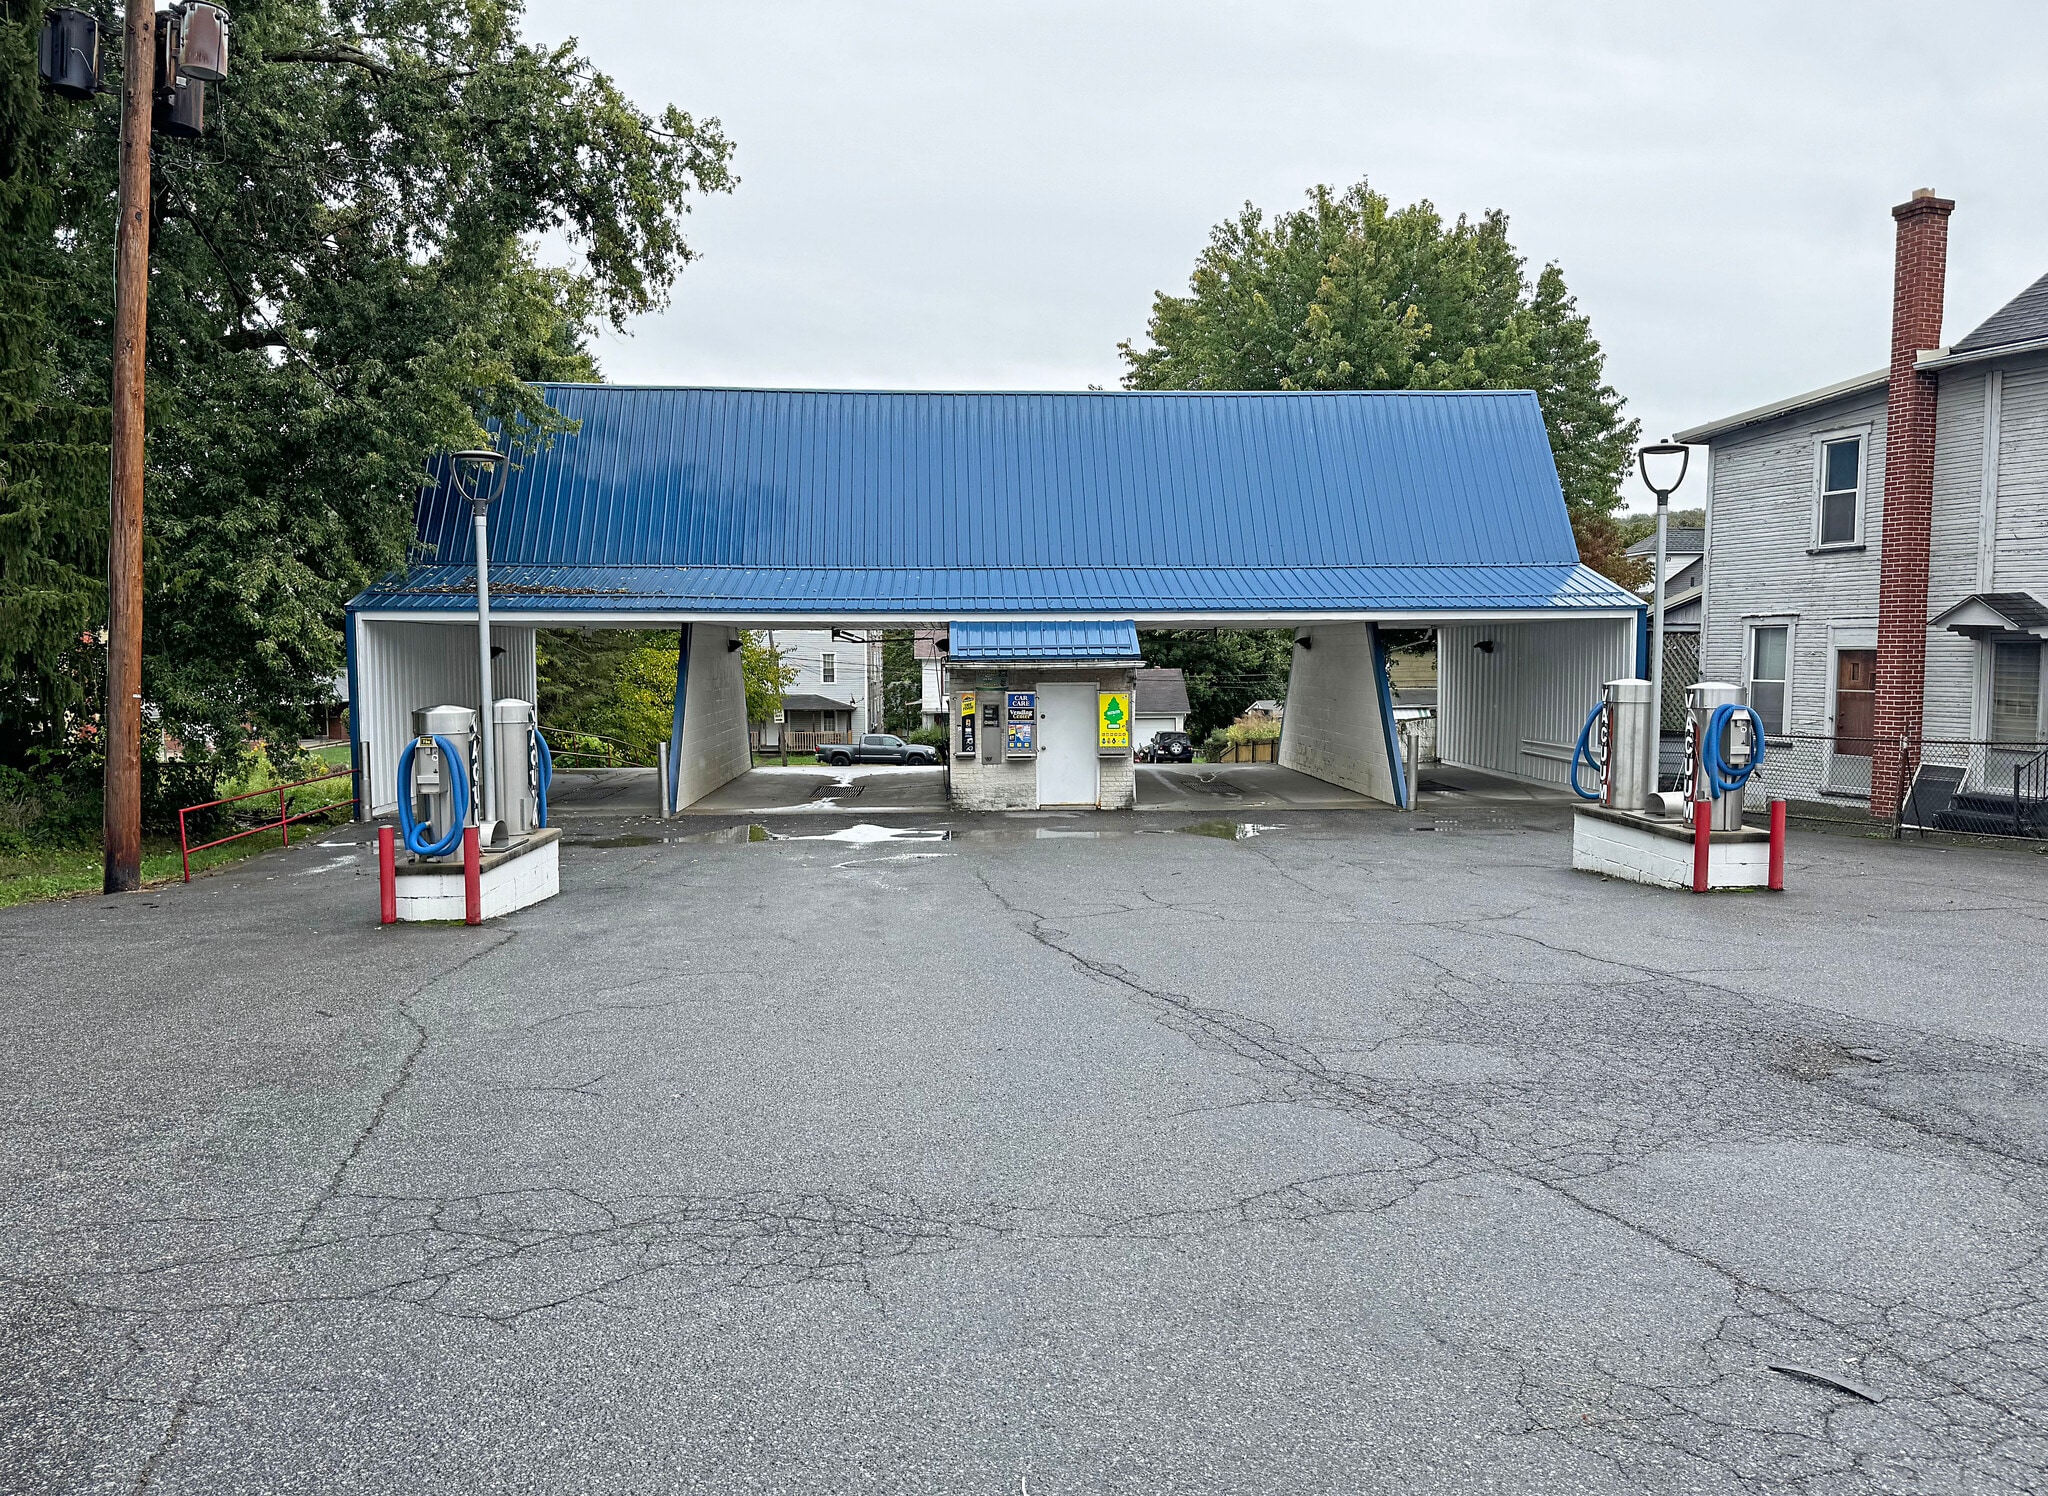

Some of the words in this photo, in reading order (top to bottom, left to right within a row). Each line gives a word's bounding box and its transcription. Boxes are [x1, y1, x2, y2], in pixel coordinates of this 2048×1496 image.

[1009, 709, 1033, 717] Vending
[1599, 688, 1608, 800] VACUUM
[1683, 693, 1694, 819] VACUUM
